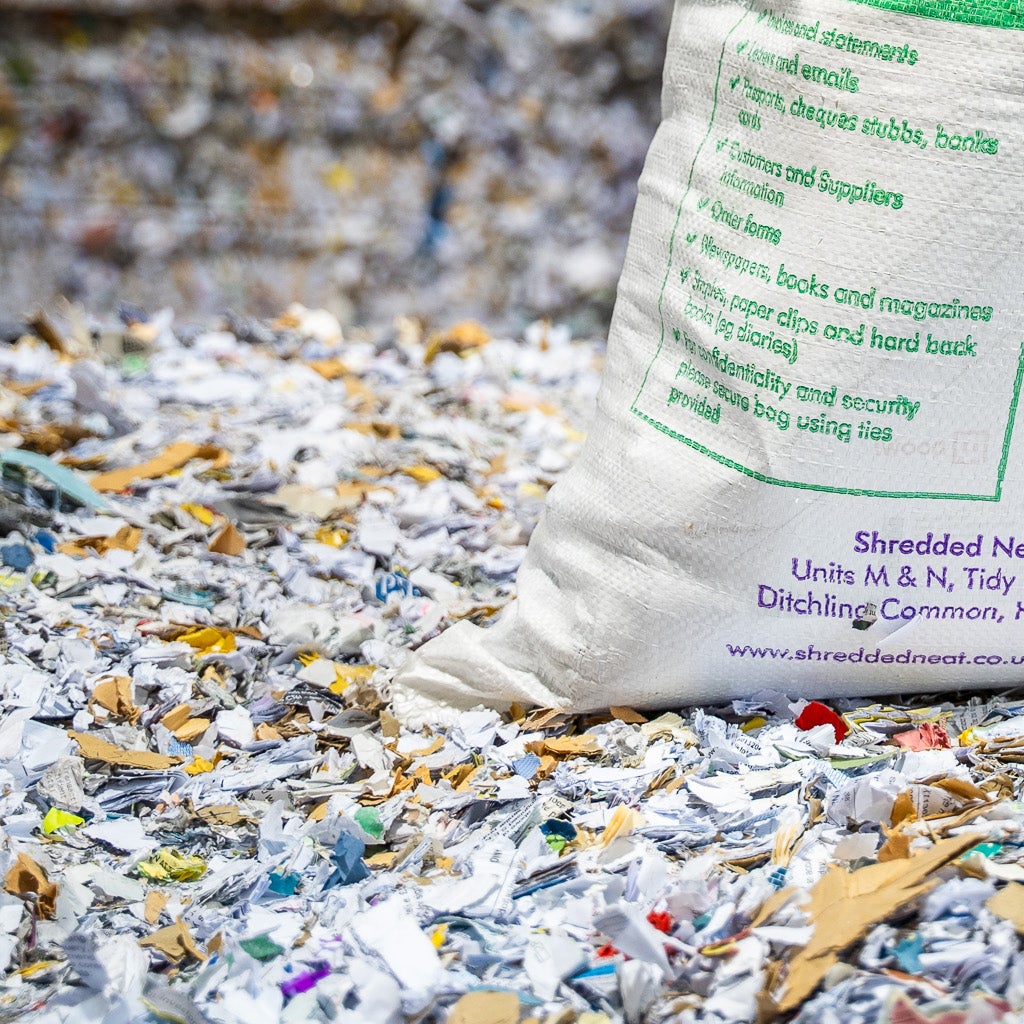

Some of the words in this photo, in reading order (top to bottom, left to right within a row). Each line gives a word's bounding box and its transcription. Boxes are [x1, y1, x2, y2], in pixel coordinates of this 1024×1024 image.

[818, 28, 918, 66] statements
[775, 53, 799, 75] and
[801, 64, 859, 94] emails
[738, 109, 761, 131] cards
[742, 76, 786, 115] Passports,
[790, 94, 858, 131] cheques
[861, 116, 928, 149] stubbs,
[935, 123, 999, 155] banks
[720, 165, 785, 208] information
[729, 140, 783, 178] Customers
[786, 165, 817, 188] and
[818, 170, 904, 210] Suppliers
[744, 213, 782, 246] forms
[700, 233, 771, 284] Newspapers,
[776, 263, 829, 299] books
[834, 286, 876, 310] and
[879, 297, 994, 323] magazines
[684, 294, 714, 325] books
[714, 310, 735, 342] (eg
[737, 320, 798, 365] diaries)
[730, 294, 774, 321] paper
[776, 307, 819, 335] clips
[823, 322, 866, 346] and
[871, 327, 919, 354] hard
[925, 332, 977, 357] back
[667, 386, 721, 424] provided
[675, 359, 711, 389] please
[713, 380, 750, 412] secure
[753, 394, 790, 430] bag
[796, 413, 852, 443] using
[858, 420, 893, 442] ties
[698, 346, 792, 401] confidentiality
[796, 385, 837, 407] and
[842, 393, 921, 422] security
[854, 530, 983, 558] Shredded
[791, 557, 855, 585] Units
[864, 564, 891, 587] M
[897, 565, 918, 587] &
[926, 565, 955, 593] N,
[962, 567, 1016, 596] Tidy
[880, 598, 1005, 624] Common,
